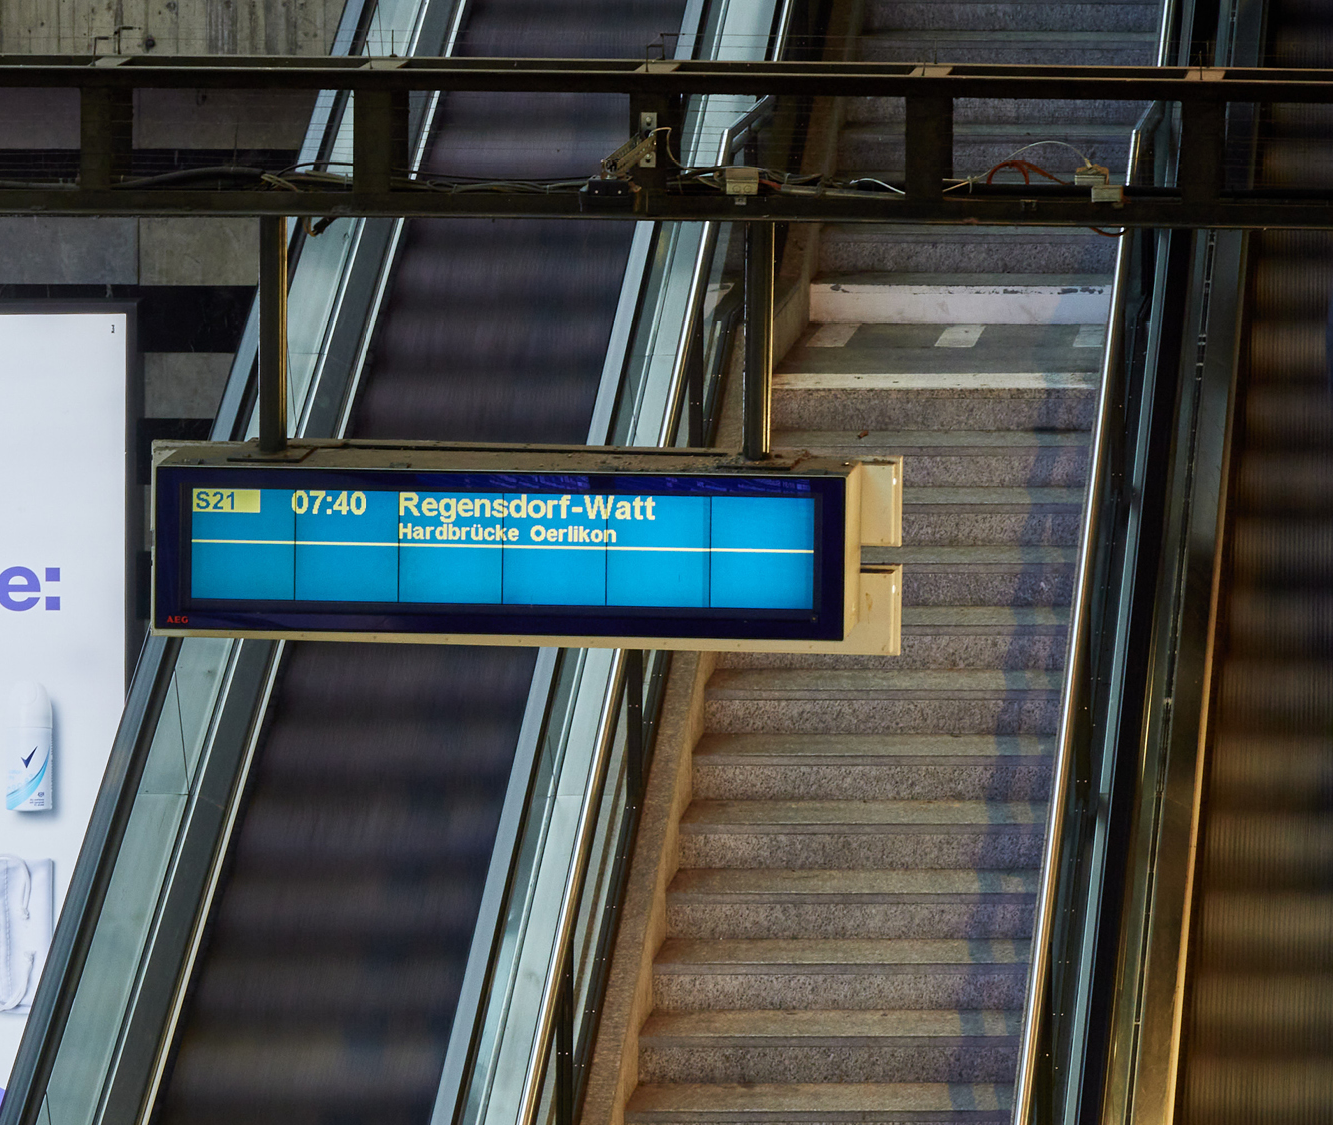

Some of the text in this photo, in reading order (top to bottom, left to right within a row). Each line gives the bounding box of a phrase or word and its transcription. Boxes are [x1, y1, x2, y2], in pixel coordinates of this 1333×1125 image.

[195, 490, 656, 522] S21 07:40 Regensdorf-Watt
[398, 522, 617, 543] Hardbrücke Oerlikon
[167, 615, 189, 624] AEG
